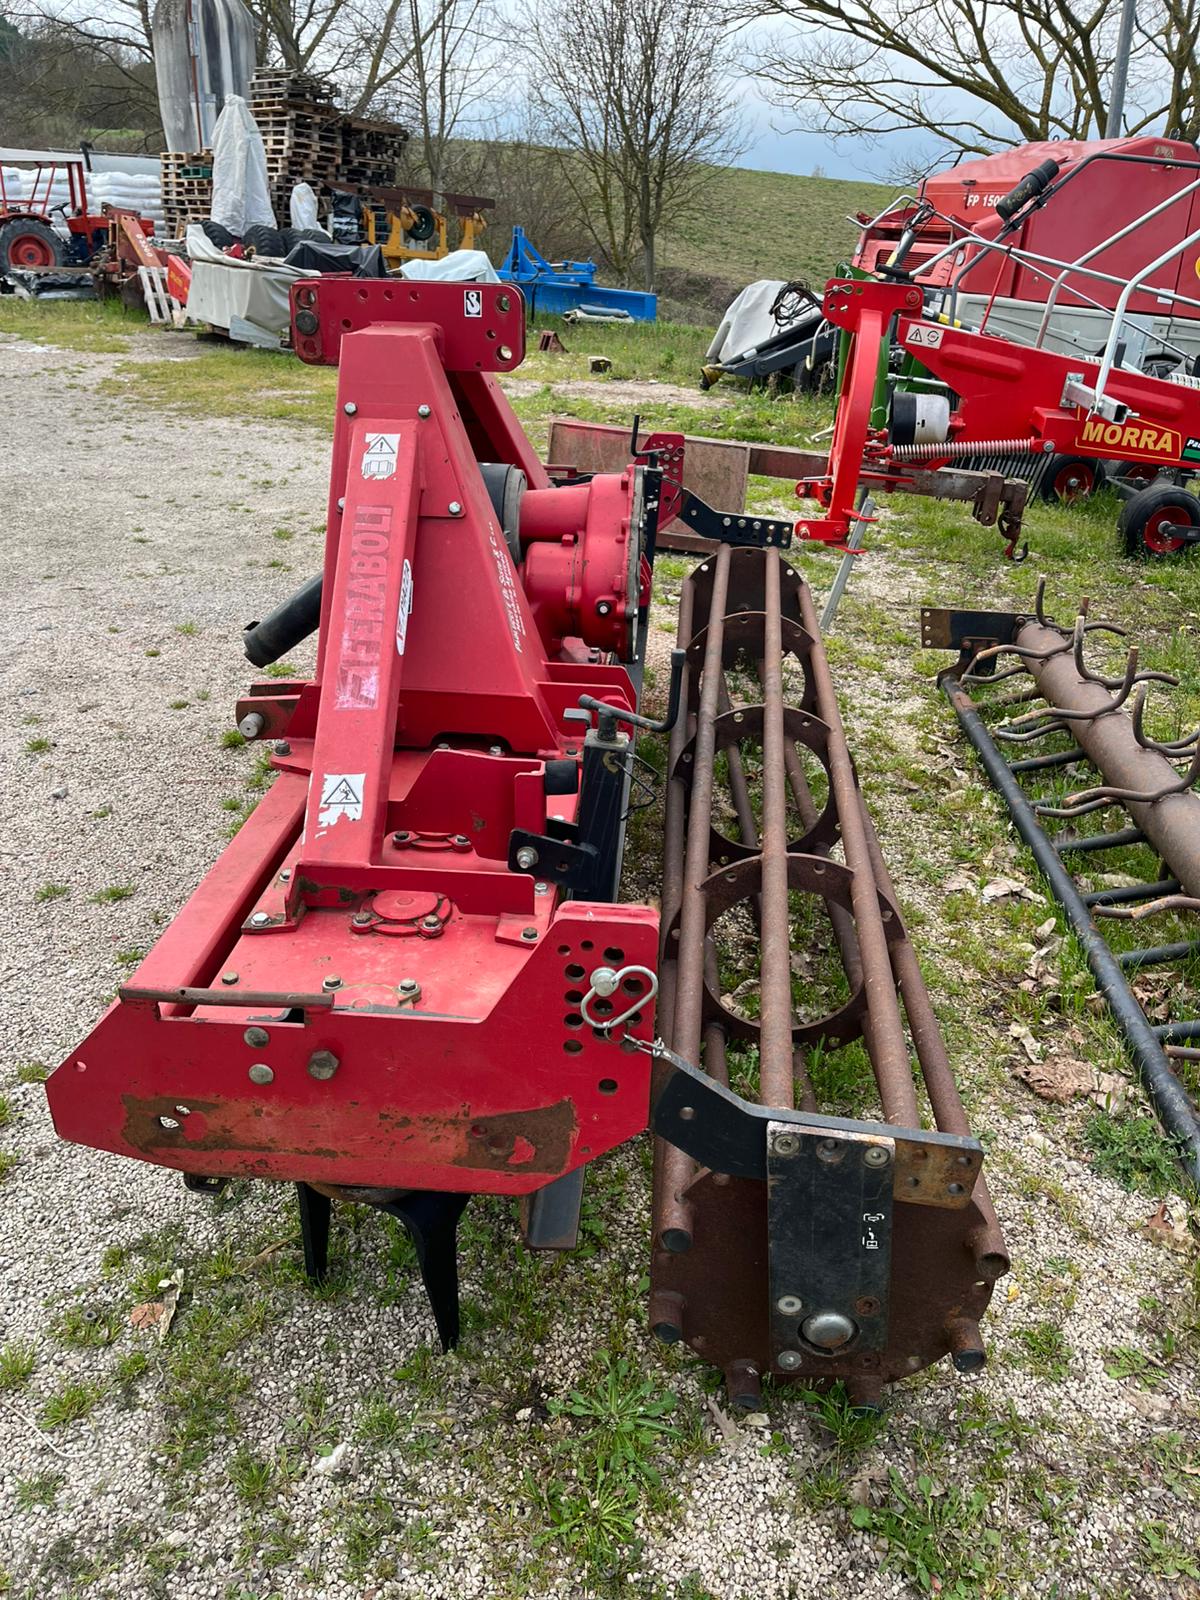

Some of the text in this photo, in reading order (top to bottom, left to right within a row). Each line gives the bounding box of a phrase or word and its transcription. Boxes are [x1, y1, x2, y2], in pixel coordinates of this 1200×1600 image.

[967, 194, 980, 207] FP
[1081, 421, 1173, 453] MORRA
[341, 505, 393, 662] FERABOLI
